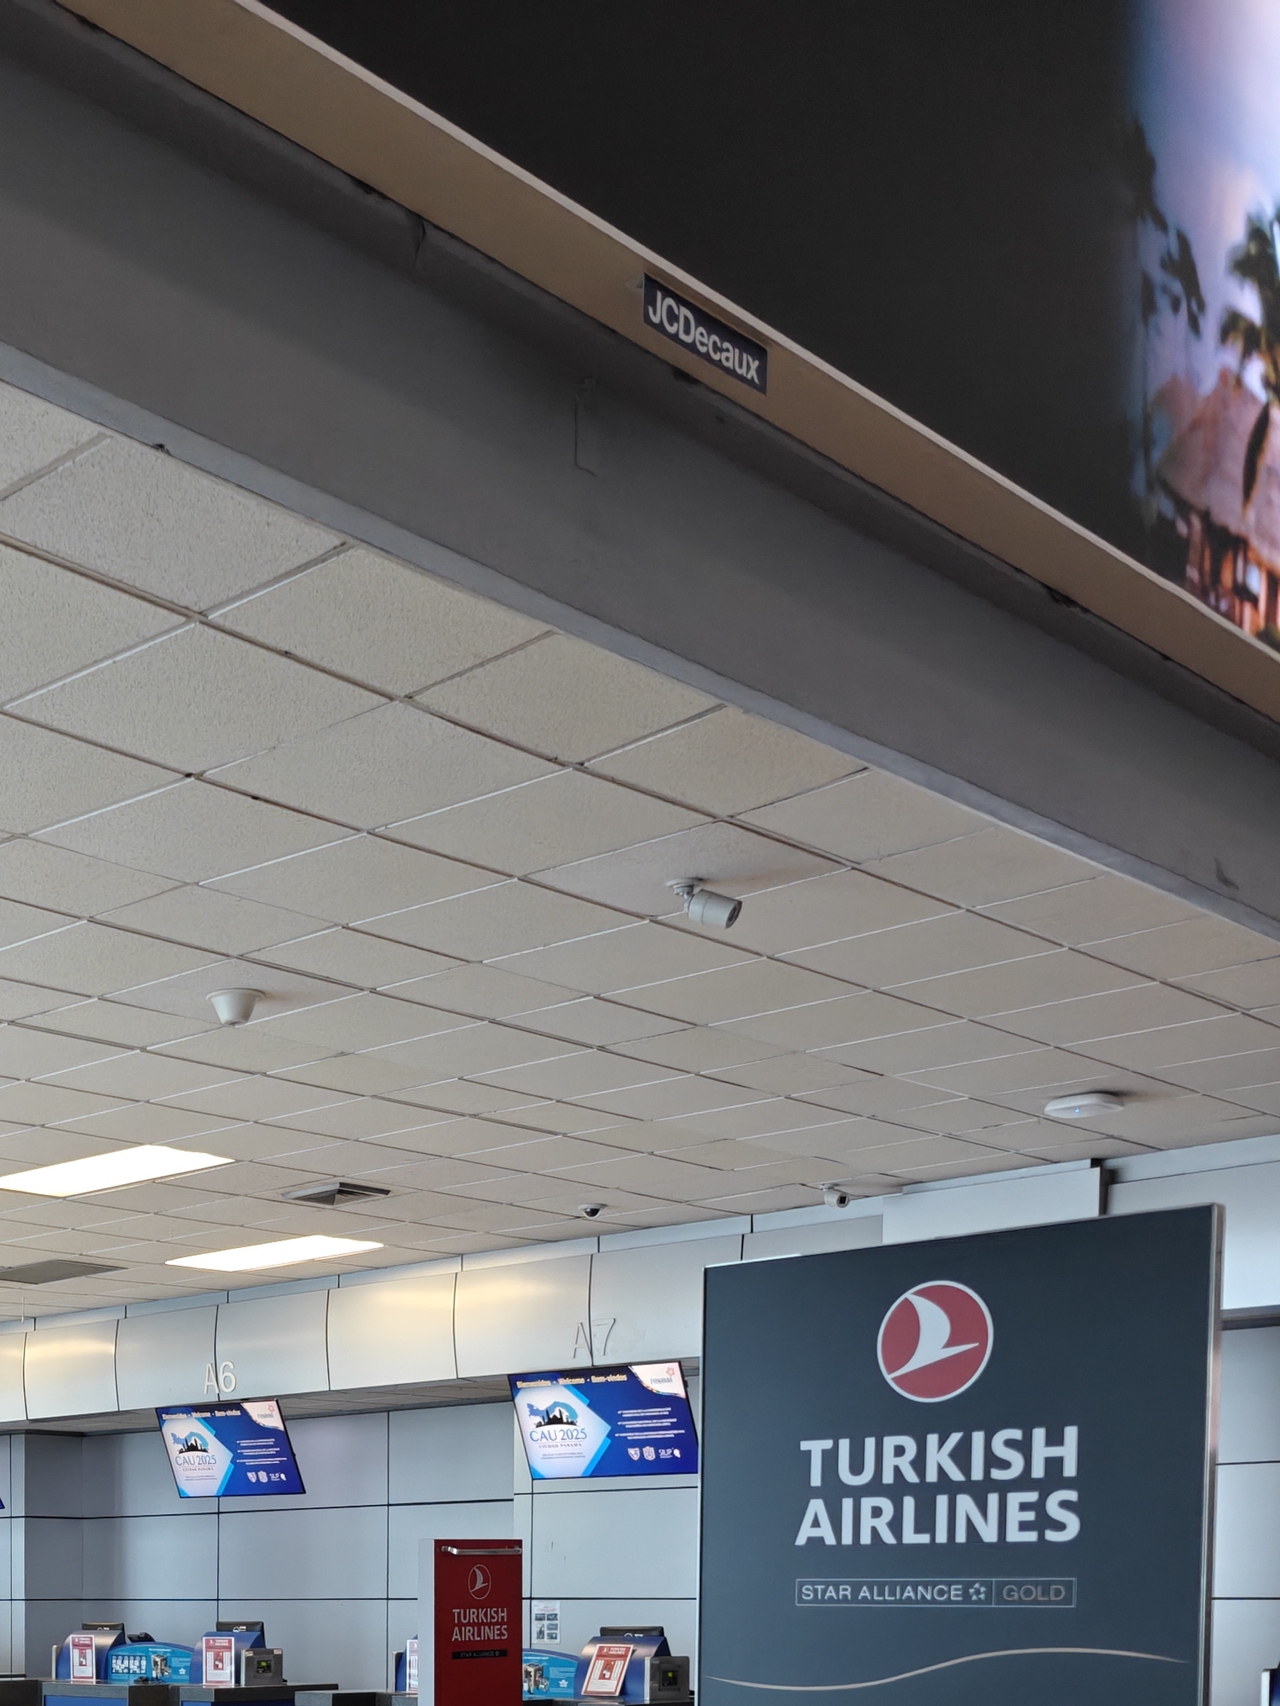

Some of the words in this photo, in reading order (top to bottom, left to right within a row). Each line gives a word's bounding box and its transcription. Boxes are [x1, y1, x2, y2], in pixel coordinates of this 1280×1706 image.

[648, 290, 760, 384] JCDecaux
[572, 1317, 616, 1359] A7
[204, 1361, 237, 1394] A6
[529, 1430, 557, 1442] CAU
[559, 1428, 588, 1440] 2025
[175, 1455, 195, 1466] CAU
[197, 1454, 217, 1465] 2025
[800, 1425, 1078, 1487] TURKISH
[794, 1489, 1081, 1546] AIRLINES
[801, 1585, 852, 1601] STAR
[858, 1585, 963, 1601] ALLIANCE
[1002, 1585, 1066, 1601] GOLD
[452, 1608, 507, 1624] TURKISH
[451, 1625, 508, 1642] AIRLINES
